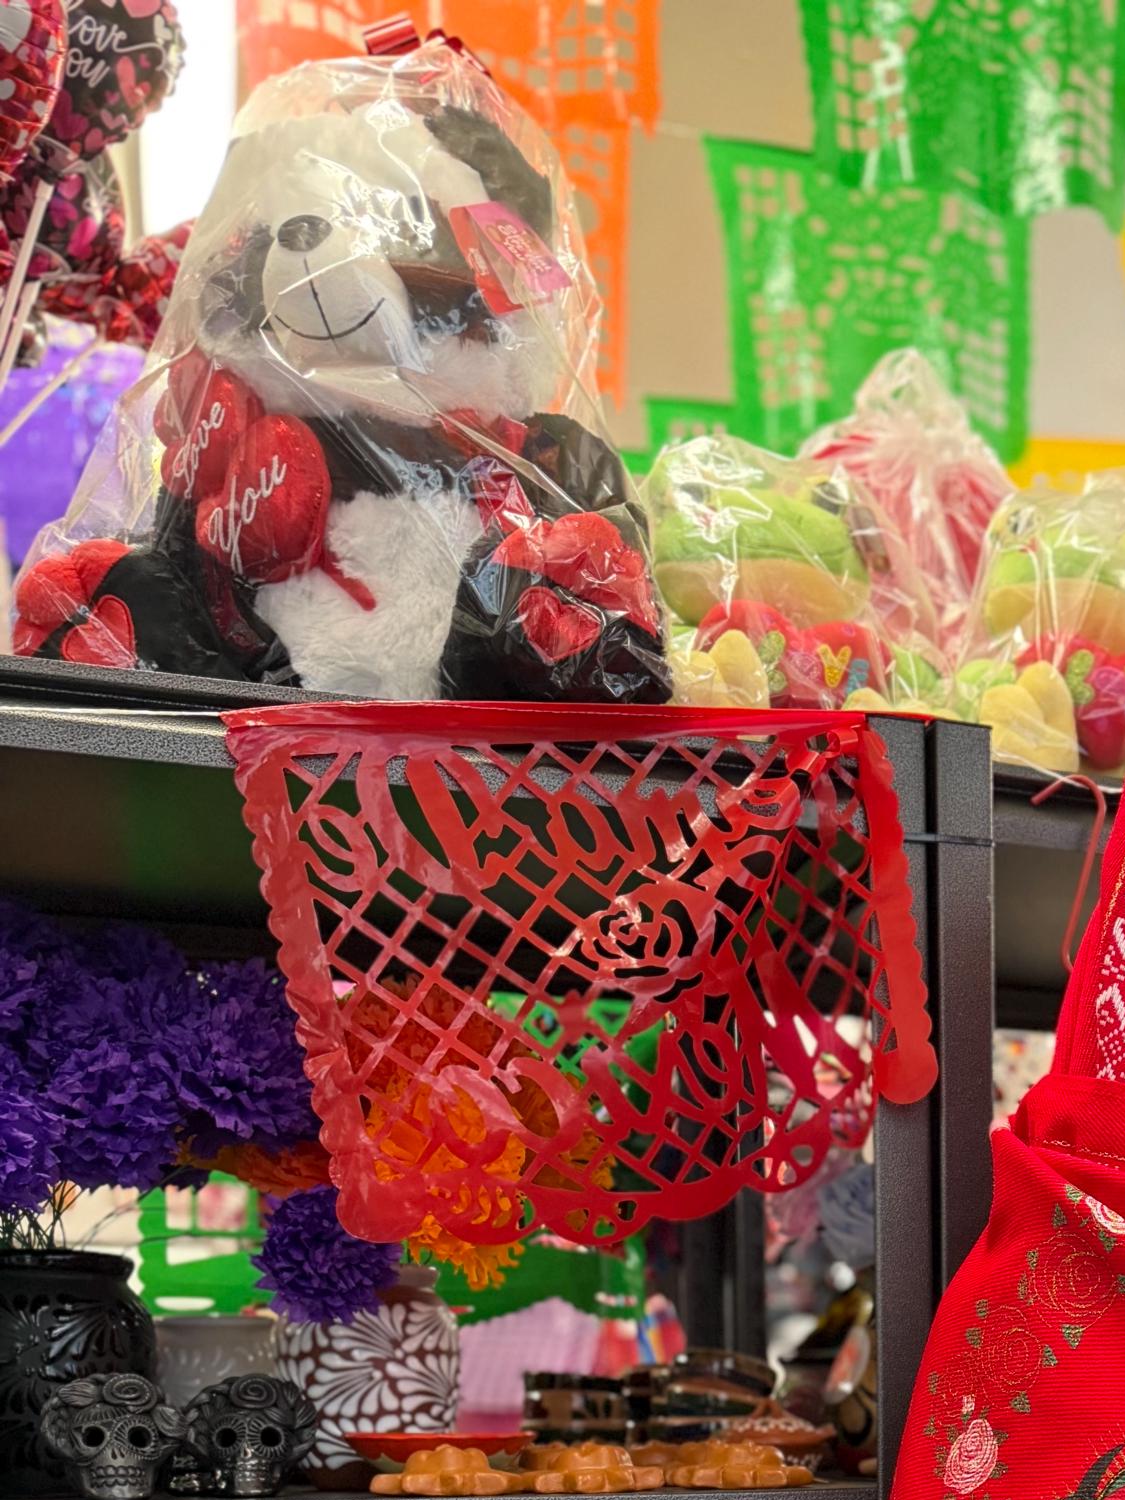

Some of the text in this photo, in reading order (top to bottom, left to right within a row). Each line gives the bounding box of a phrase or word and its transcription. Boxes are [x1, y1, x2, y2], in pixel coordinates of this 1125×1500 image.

[65, 47, 111, 89] ou
[172, 401, 226, 499] Love
[207, 454, 288, 576] You
